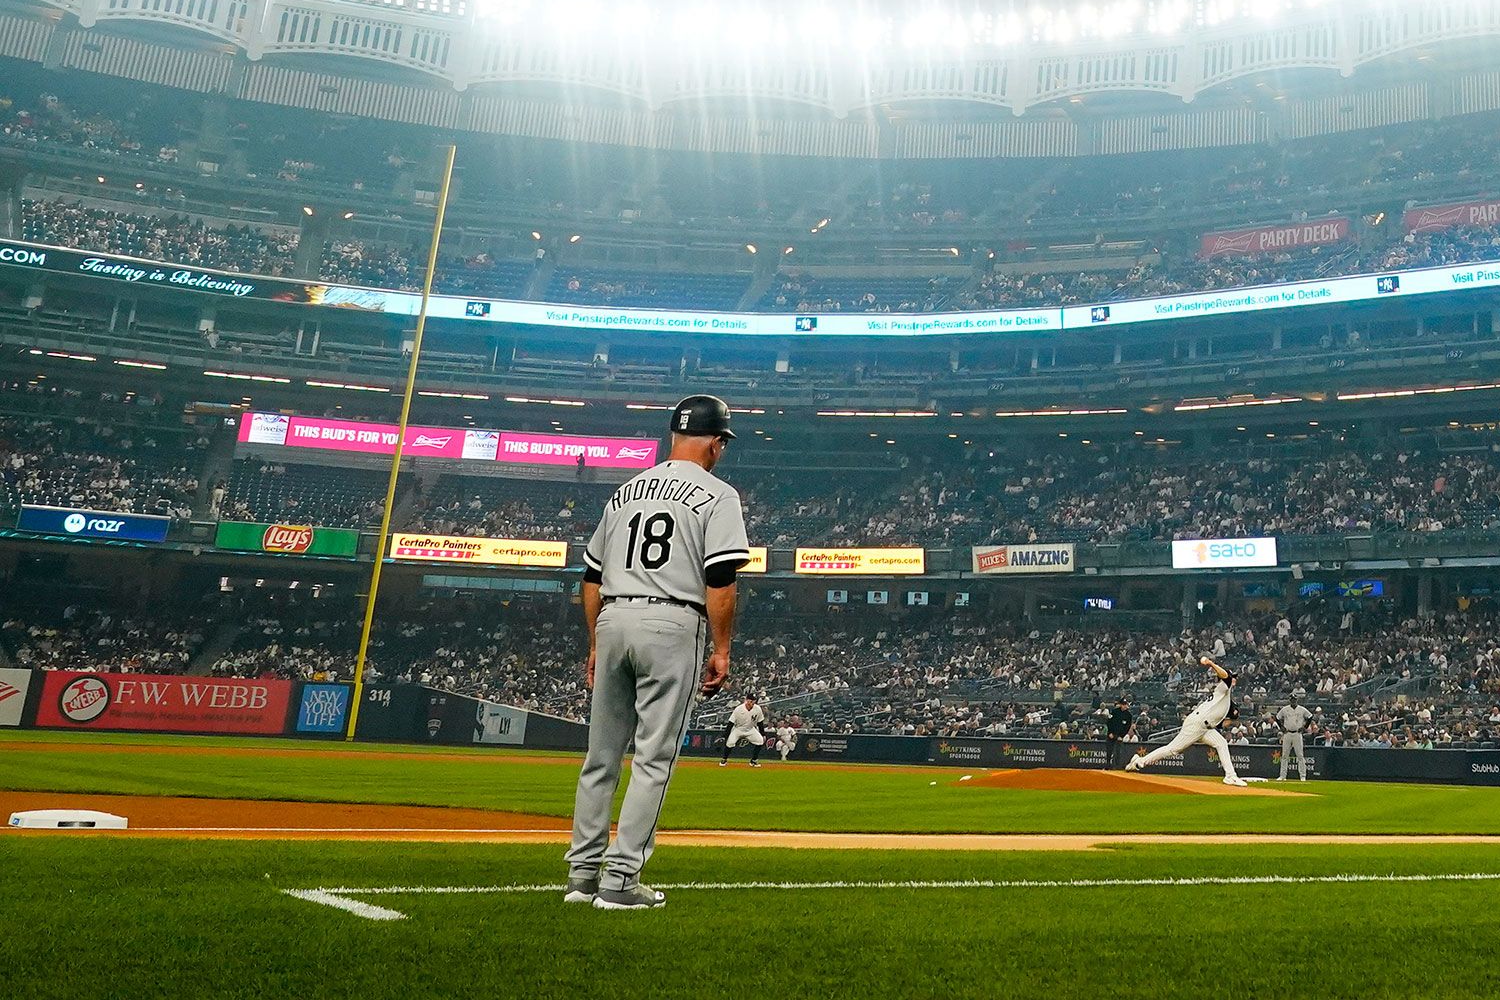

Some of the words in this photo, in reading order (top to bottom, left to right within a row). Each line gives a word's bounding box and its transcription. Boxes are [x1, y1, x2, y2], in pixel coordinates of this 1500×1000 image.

[1259, 228, 1301, 250] PARTY
[1303, 223, 1339, 243] DECK
[79, 257, 147, 282] Tasting
[149, 268, 166, 281] is
[169, 269, 254, 297] Believing
[1452, 271, 1475, 284] Visit
[1154, 303, 1173, 314] Visit
[1175, 294, 1280, 312] PinstripeRewards.com
[1281, 291, 1295, 301] for
[1298, 287, 1332, 299] Details
[546, 311, 568, 321] Visit
[571, 312, 691, 328] PinstripeRewards.com
[693, 318, 709, 328] for
[711, 319, 748, 330] Details
[866, 320, 888, 331] Visit
[890, 317, 997, 331] PinstripeRewards.com
[999, 316, 1013, 326] for
[1015, 315, 1049, 326] Details
[680, 414, 690, 424] 18
[294, 424, 320, 439] THIS
[321, 427, 356, 442] BUD'S
[357, 430, 380, 444] FOR
[504, 441, 529, 453] THIS
[530, 442, 563, 456] BUD'S
[564, 445, 586, 457] FOR
[586, 445, 611, 458] YOU.
[611, 478, 716, 516] RODRIGUEZ
[87, 518, 126, 533] razr
[266, 525, 310, 550] Lay's
[398, 537, 440, 549] CertaPro
[442, 539, 482, 551] Painters
[624, 509, 676, 572] 18
[492, 548, 562, 560] certapro.com
[801, 553, 833, 563] CertaPro
[833, 553, 862, 563] Painters
[981, 553, 1006, 567] MIKE'S
[1011, 550, 1069, 567] AMAZING
[869, 557, 921, 567] certapro.com
[70, 690, 100, 709] WEBB
[114, 680, 172, 706] F.W.
[180, 683, 269, 709] WEBB
[309, 690, 342, 702] NEW
[369, 689, 391, 701] 314
[304, 701, 342, 715] YORK
[306, 713, 336, 726] LIFE
[940, 745, 982, 754] DRAFTKINGS
[949, 752, 981, 760] SPORTSBOOK
[1003, 747, 1046, 756] DRAFTKINGS
[1013, 754, 1045, 762] SPORTSBOOK
[1471, 763, 1500, 773] StubHub
